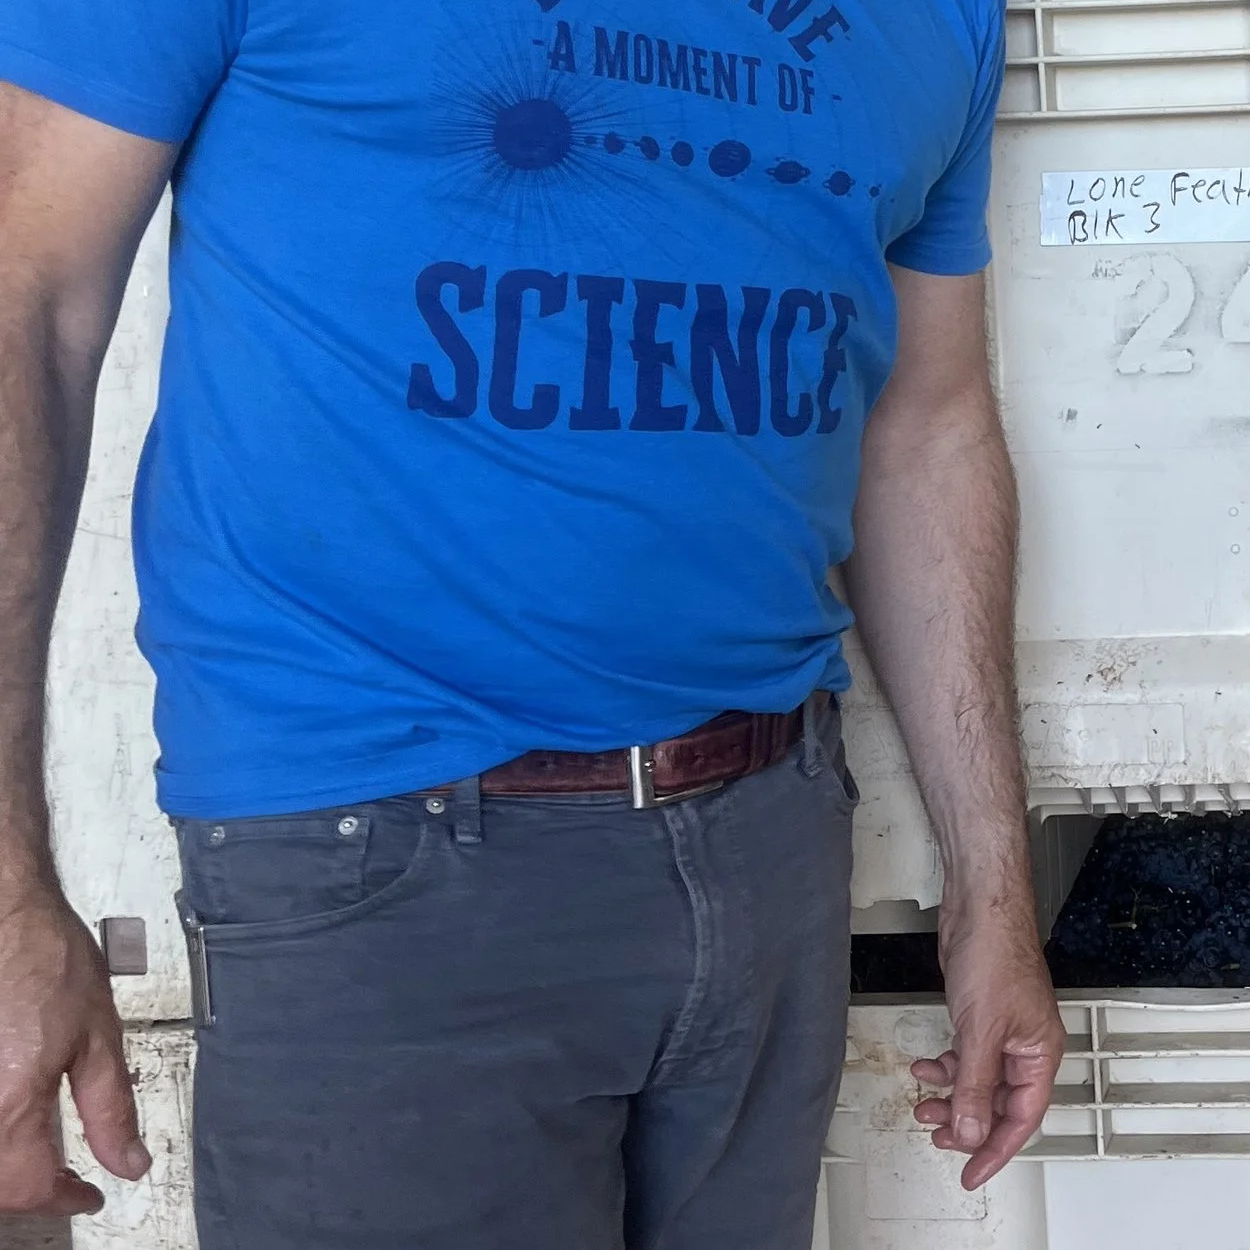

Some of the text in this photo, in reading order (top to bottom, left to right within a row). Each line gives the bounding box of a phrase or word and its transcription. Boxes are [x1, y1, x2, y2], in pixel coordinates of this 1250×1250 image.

[592, 25, 762, 106] MOMENT
[777, 65, 816, 115] OF
[1067, 174, 1145, 206] Lone
[1142, 202, 1162, 234] 3
[406, 261, 859, 438] SCIENCE
